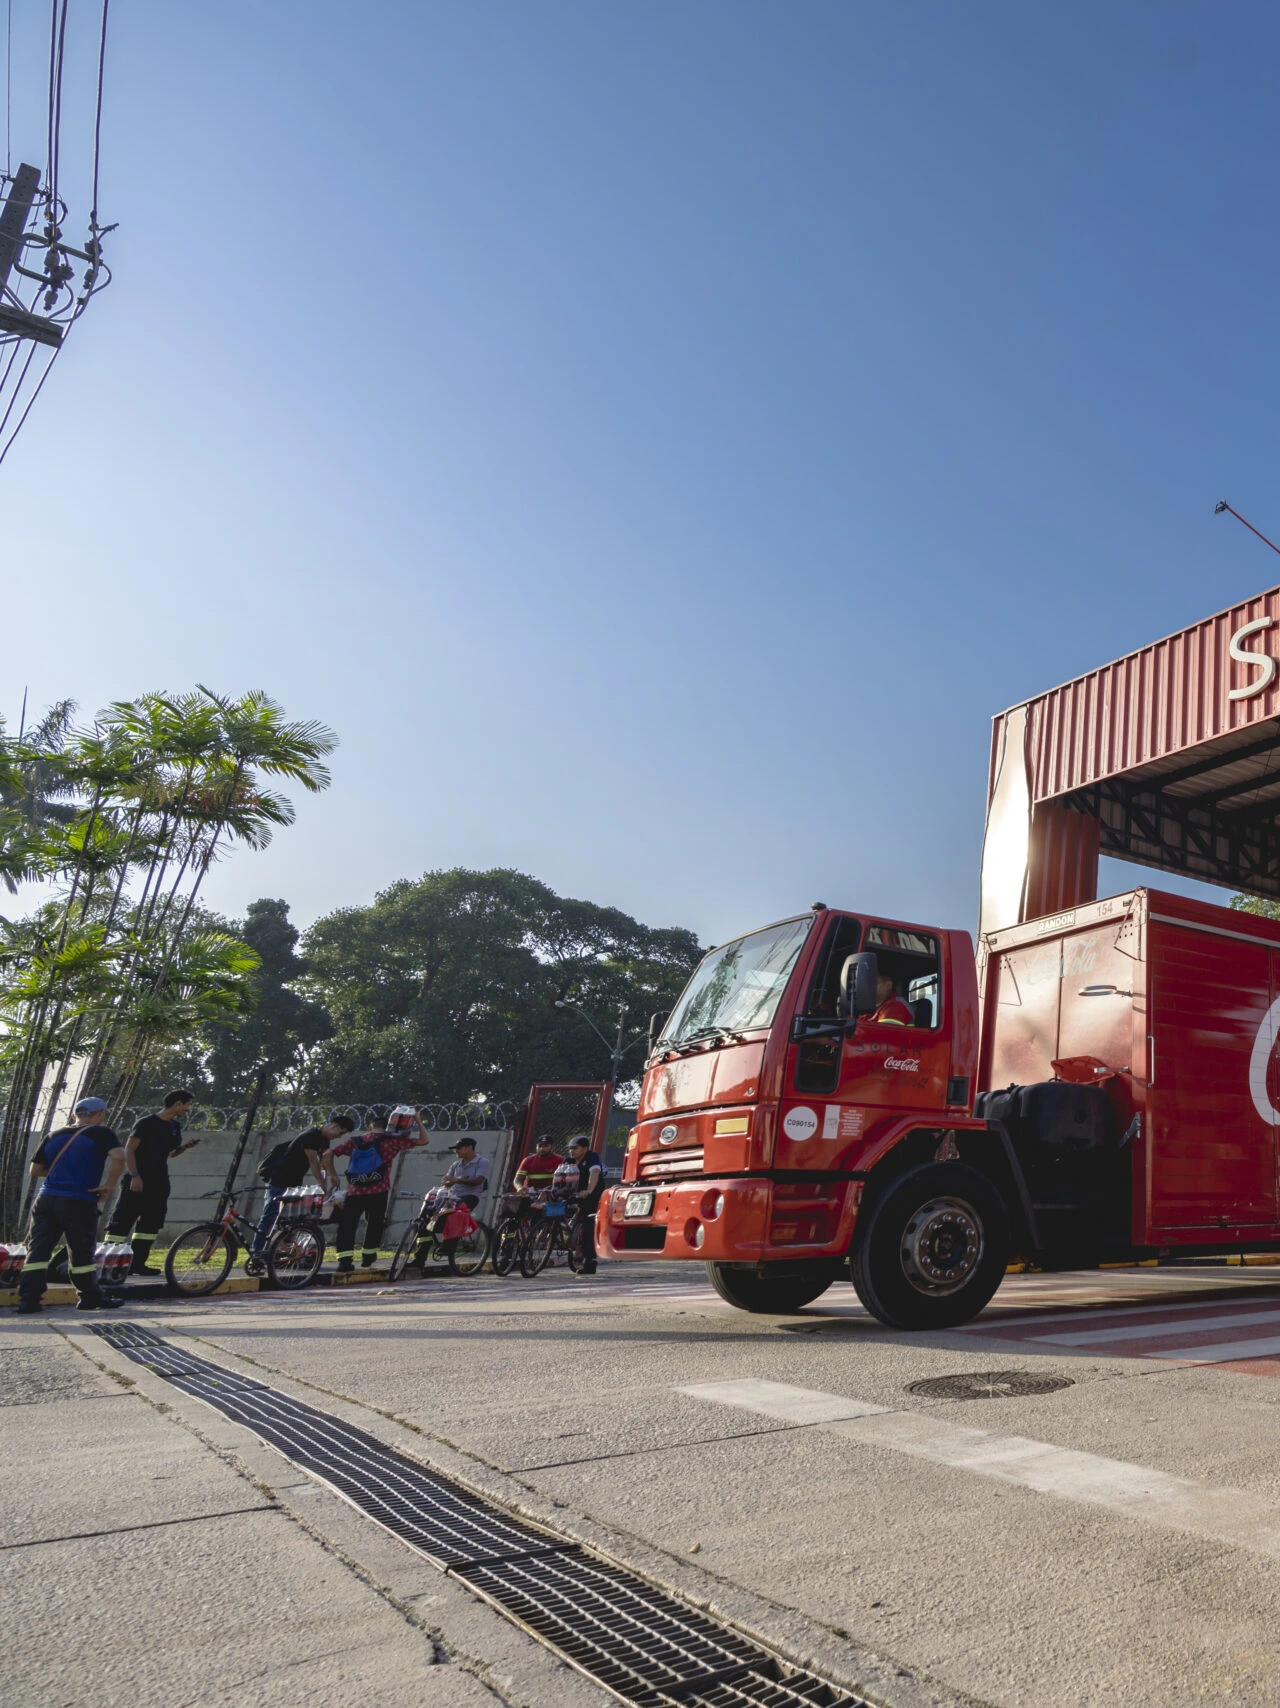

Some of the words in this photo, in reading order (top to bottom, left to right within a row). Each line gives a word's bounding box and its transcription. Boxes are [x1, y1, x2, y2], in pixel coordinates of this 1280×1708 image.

[1097, 902, 1113, 917] 154
[1038, 914, 1074, 931] RANDON
[856, 1040, 922, 1055] SOLAR
[787, 1119, 815, 1128] C090154
